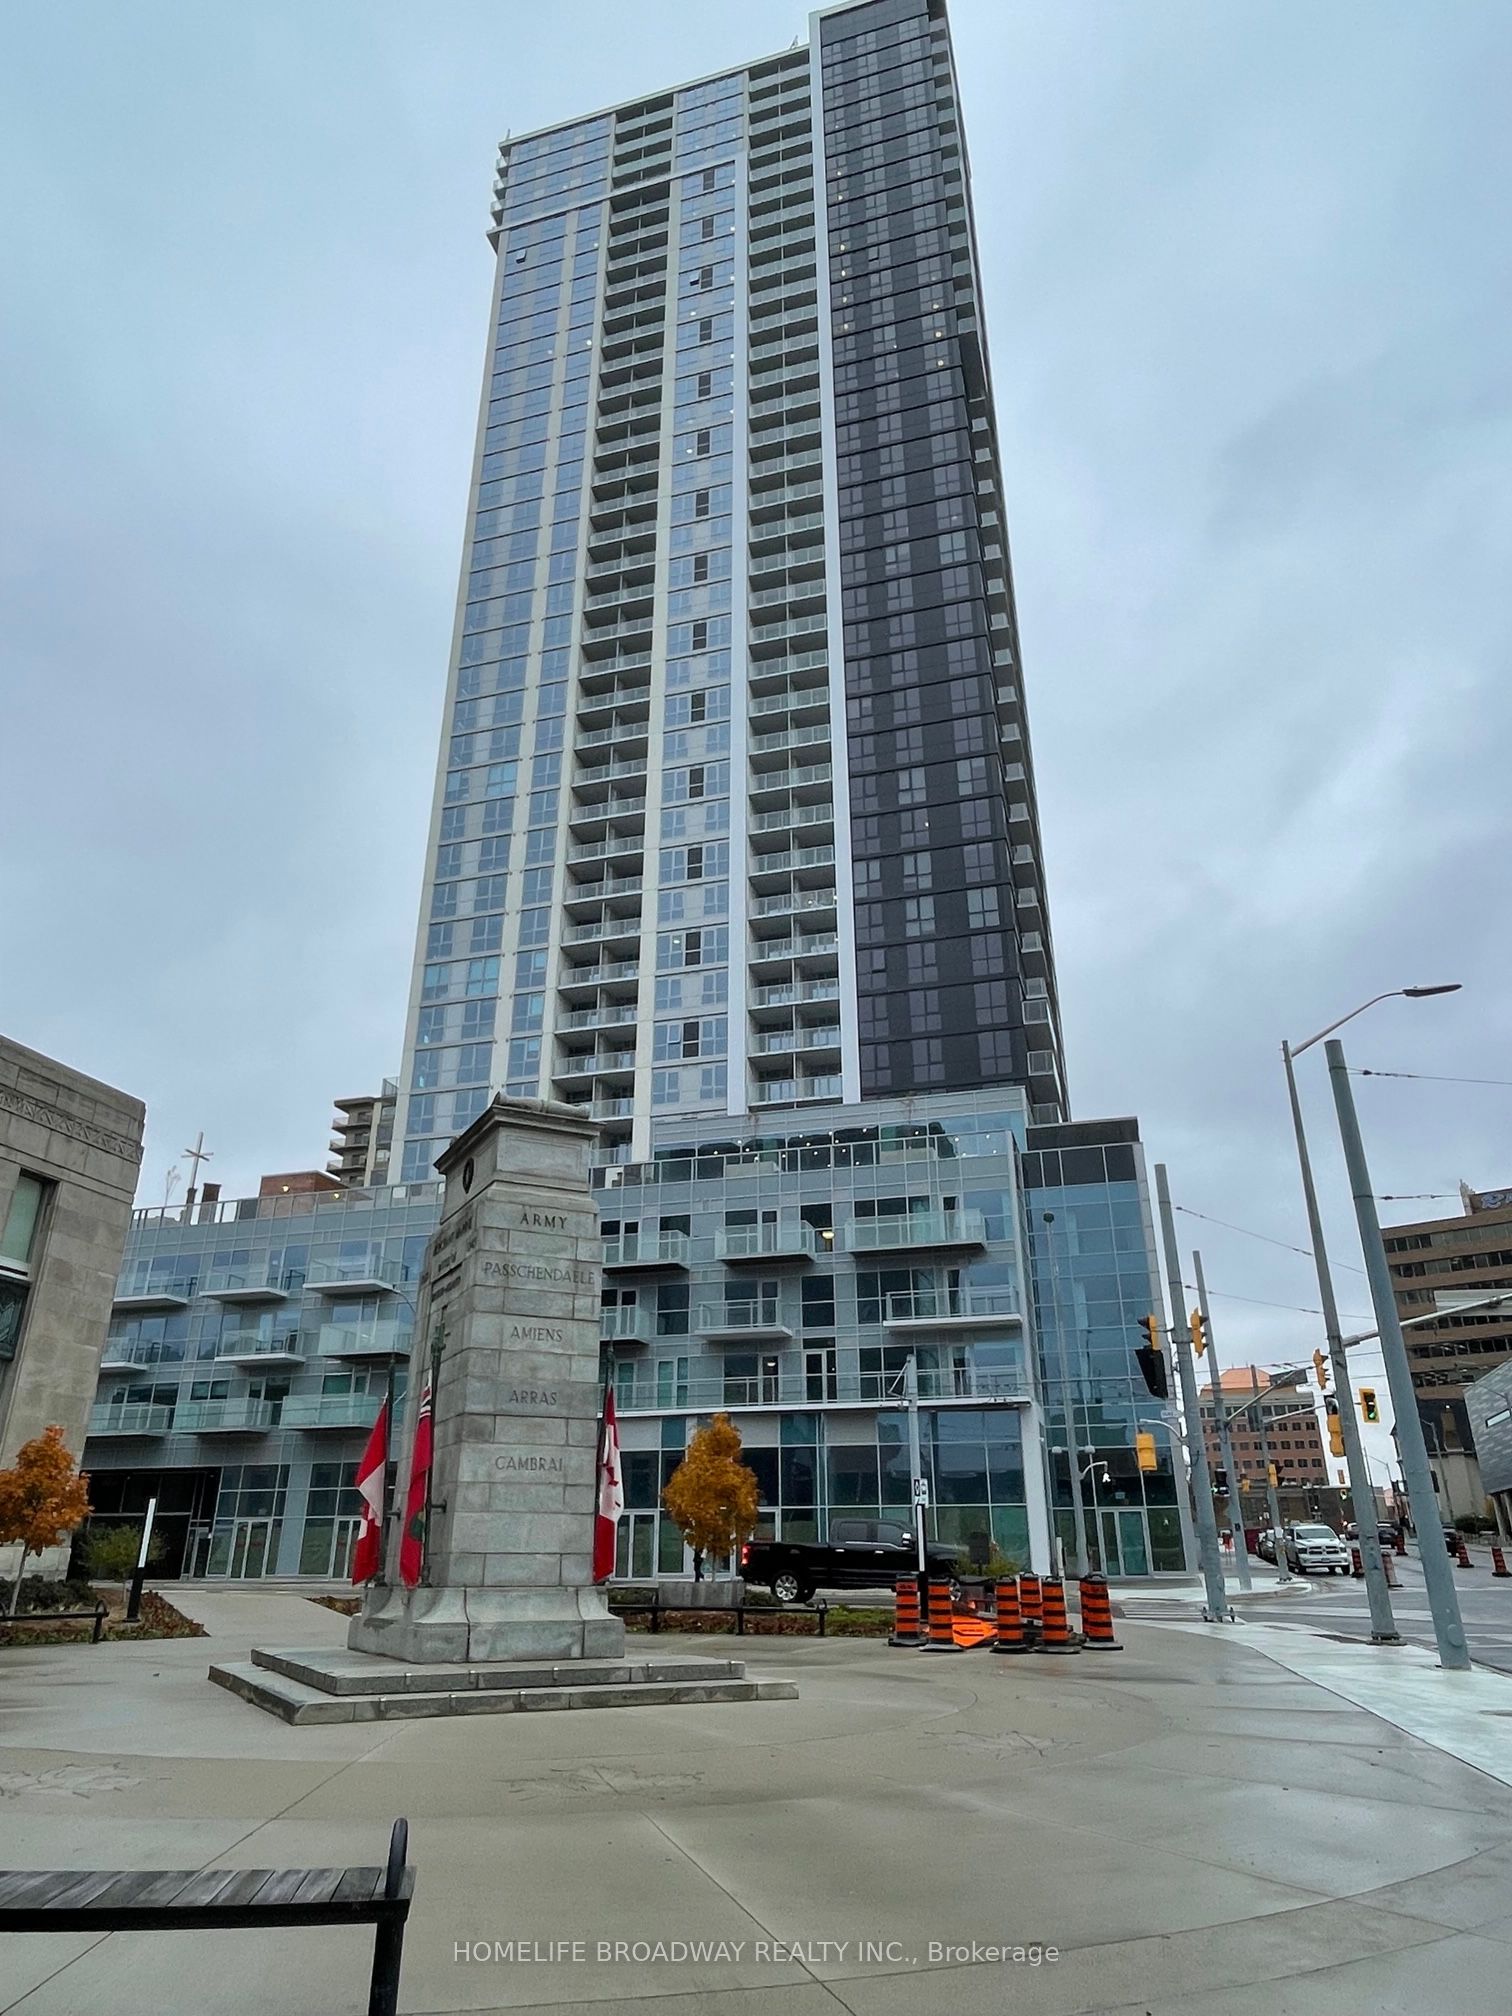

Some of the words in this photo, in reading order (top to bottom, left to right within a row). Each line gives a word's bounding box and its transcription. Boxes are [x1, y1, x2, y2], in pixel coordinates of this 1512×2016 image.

[520, 1212, 567, 1229] ARMY
[483, 1262, 595, 1285] PASSCHENDAELE
[510, 1325, 563, 1342] AMIENS
[509, 1389, 557, 1405] ARRAS
[495, 1455, 563, 1471] CAMBRAI
